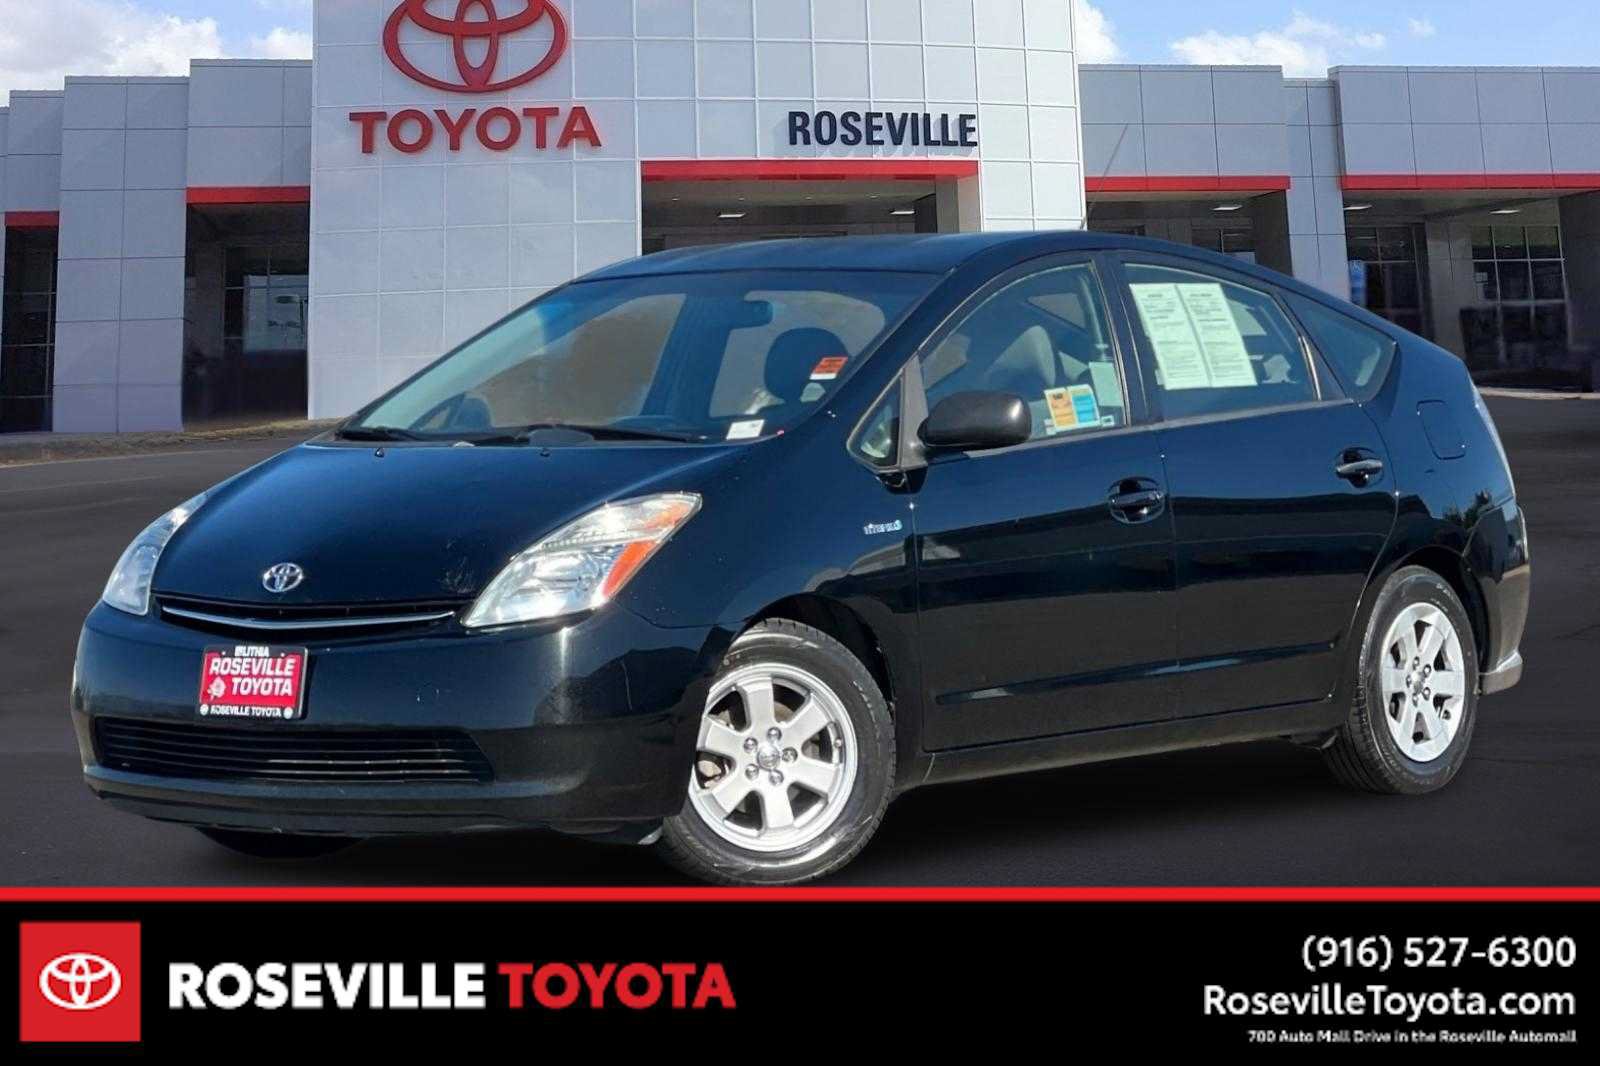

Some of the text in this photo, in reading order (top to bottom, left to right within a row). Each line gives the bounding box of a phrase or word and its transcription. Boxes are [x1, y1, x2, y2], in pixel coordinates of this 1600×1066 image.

[349, 105, 602, 154] TOYOTA
[788, 111, 978, 146] ROSEVILLE
[209, 658, 295, 675] ROSEVILLE
[232, 677, 293, 696] TOYOTA
[210, 705, 282, 717] ROSEVILLE TOYOTA
